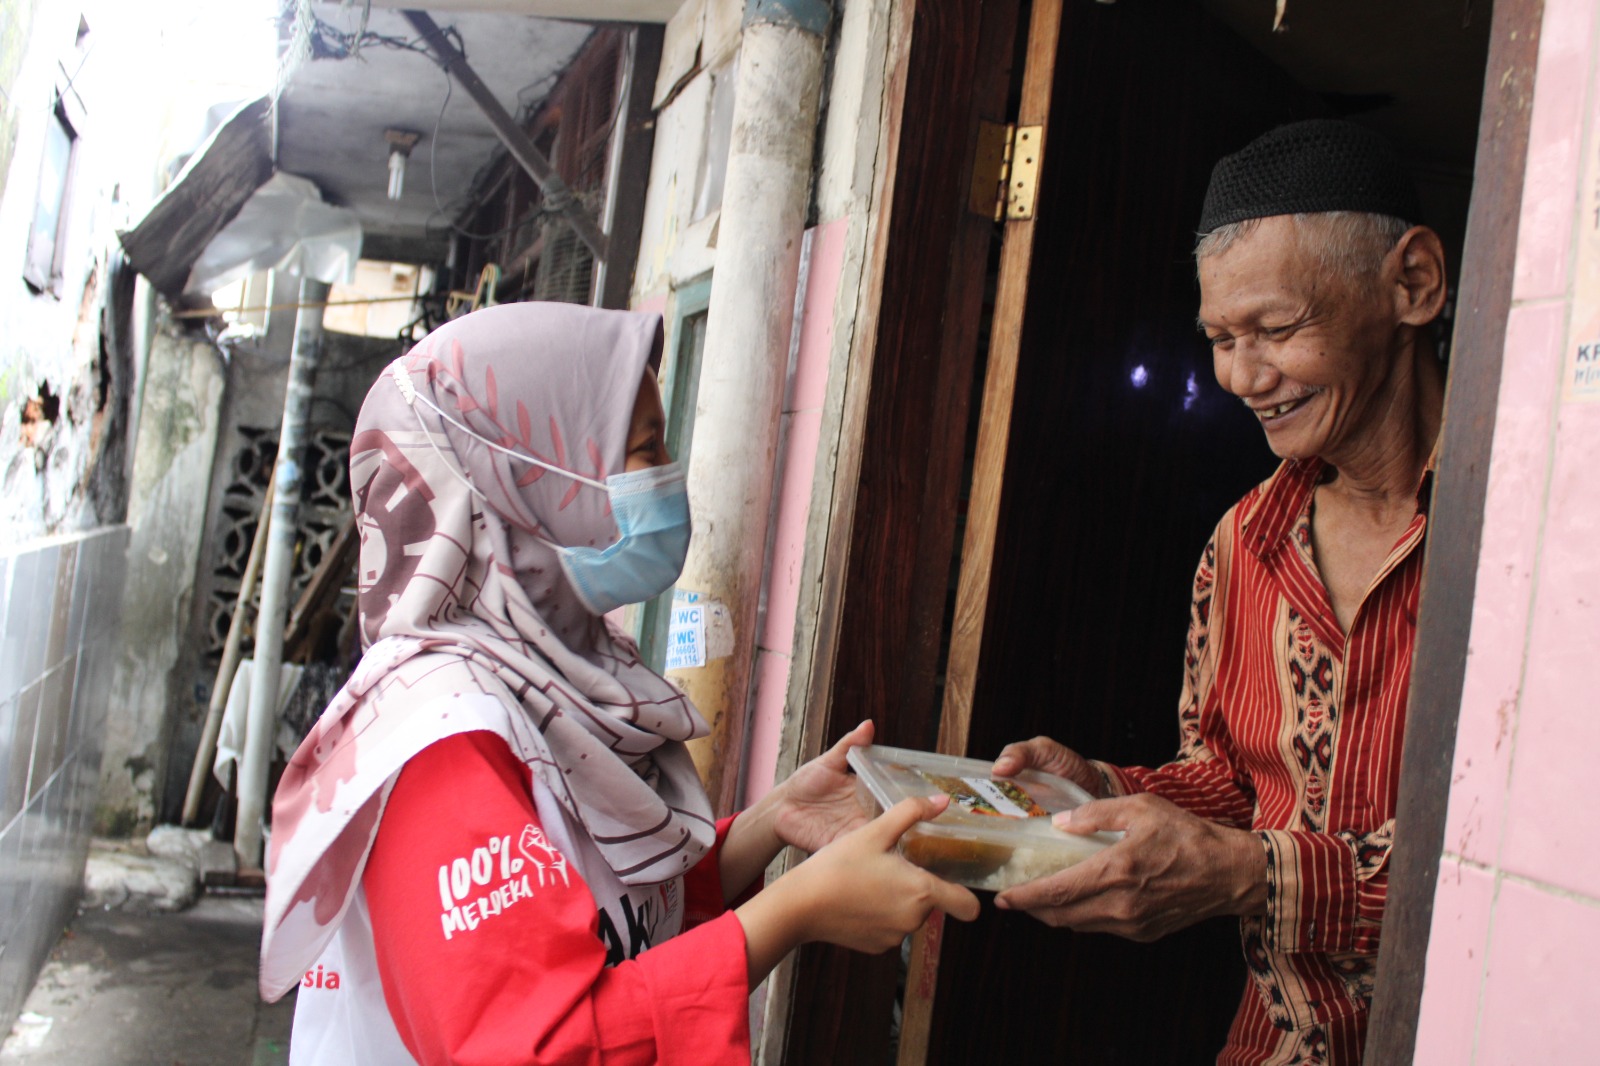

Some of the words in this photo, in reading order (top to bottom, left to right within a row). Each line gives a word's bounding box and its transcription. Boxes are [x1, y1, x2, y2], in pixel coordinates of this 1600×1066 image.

[678, 610, 699, 624] WC
[676, 630, 695, 645] WC
[438, 835, 525, 911] 100%
[440, 874, 534, 941] MERDEKA
[301, 964, 340, 990] sia
